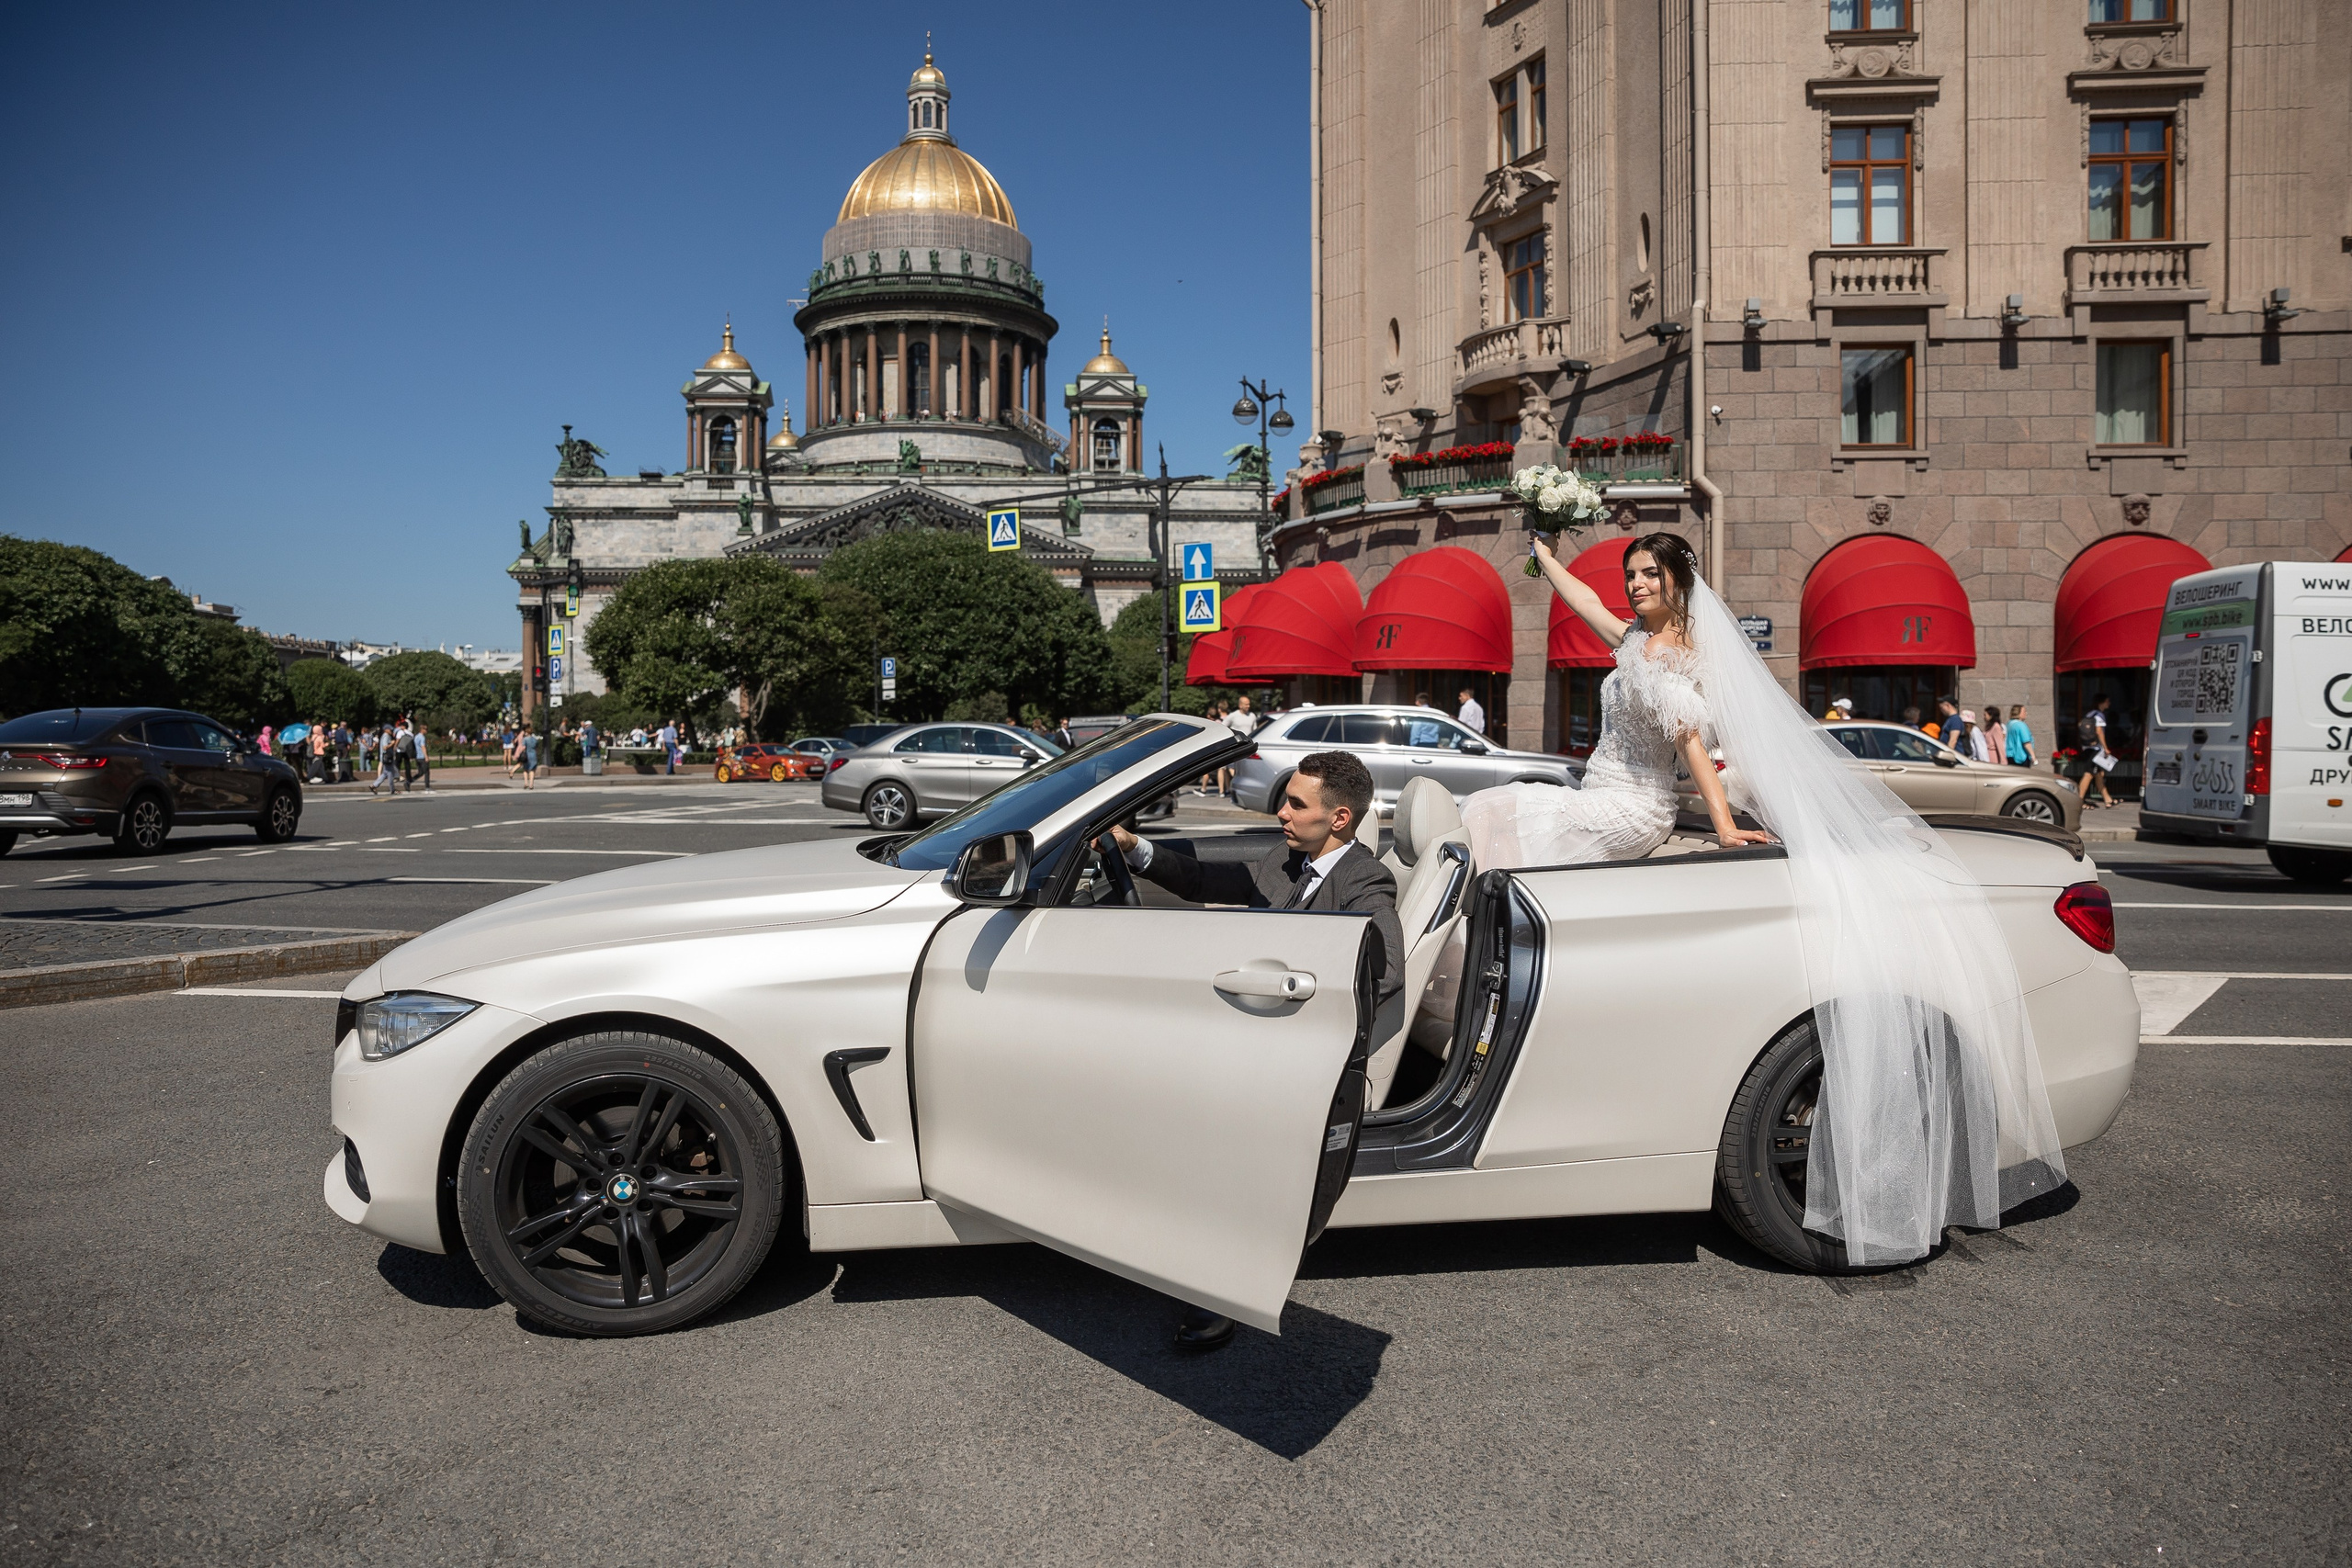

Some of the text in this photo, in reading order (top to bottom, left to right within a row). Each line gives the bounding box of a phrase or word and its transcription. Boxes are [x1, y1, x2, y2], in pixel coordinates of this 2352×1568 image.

[2175, 581, 2243, 605] ВЕЛОШЕРИНГ
[2182, 611, 2243, 628] www.spb.bike
[2192, 797, 2236, 811] SMART BIKE
[643, 1055, 702, 1079] 235/45ZR18
[479, 1114, 505, 1165] SAILUN
